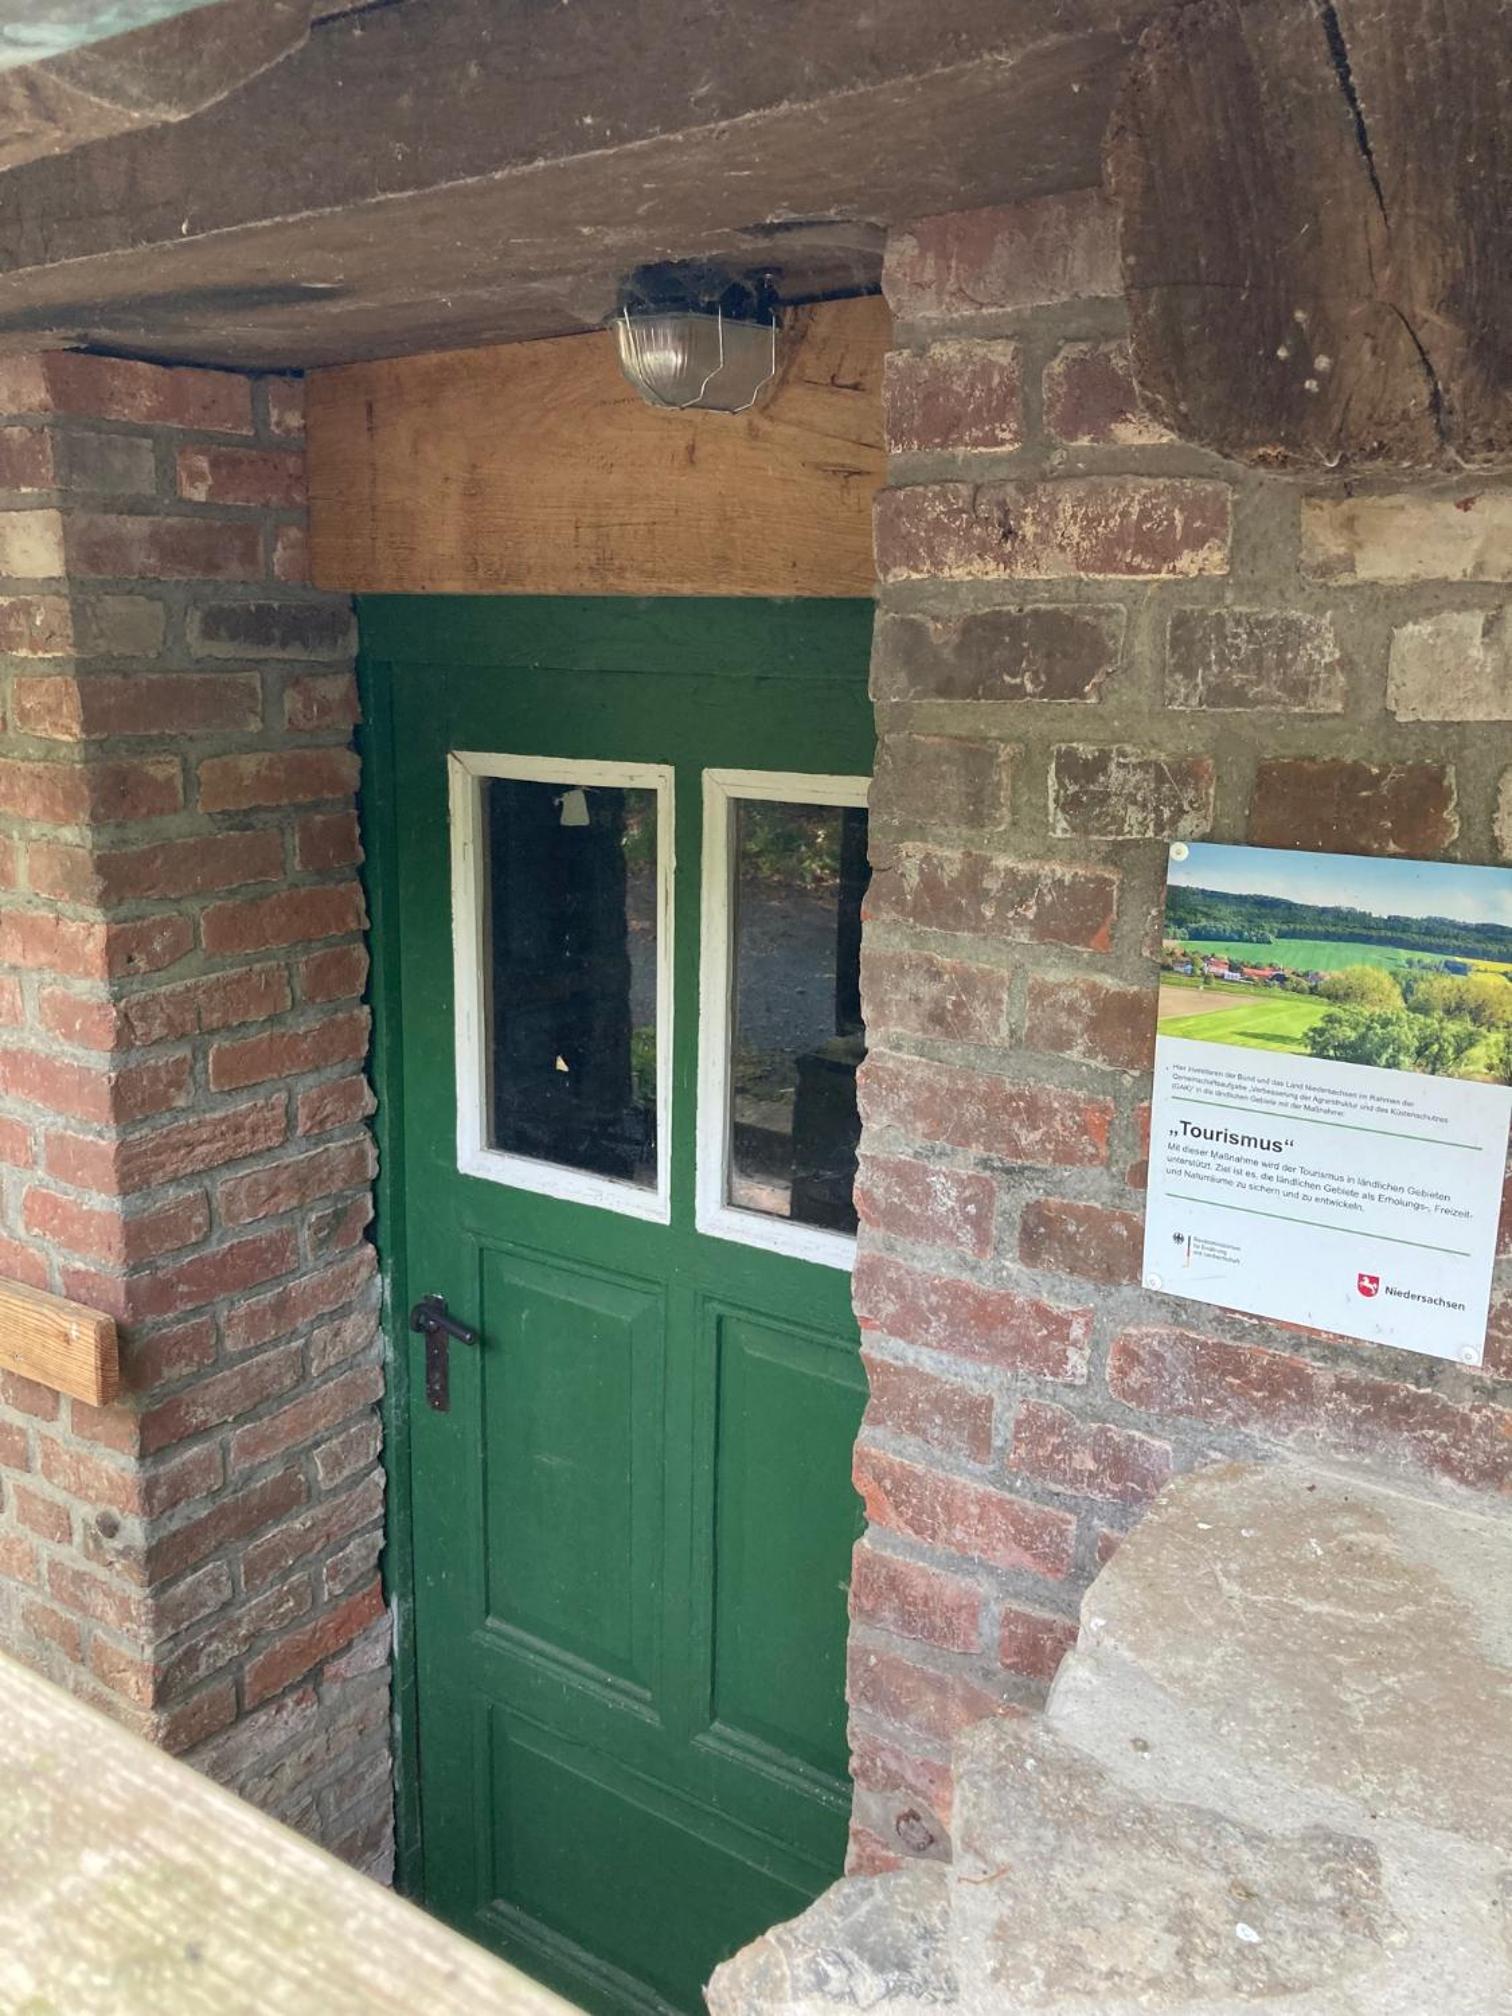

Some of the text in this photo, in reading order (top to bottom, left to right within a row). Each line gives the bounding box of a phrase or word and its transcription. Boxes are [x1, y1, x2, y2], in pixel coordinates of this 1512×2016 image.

[1237, 1073, 1255, 1082] Bund
[1286, 1080, 1304, 1089] Land
[1360, 1104, 1374, 1112] und
[1169, 1119, 1294, 1153] „Tourismus“
[1168, 1142, 1451, 1202] Mit dieser Maßnahme wird der Tourismus in ländlichen Gebieten
[1215, 1163, 1231, 1173] Ziel
[1233, 1167, 1243, 1176] ist
[1260, 1172, 1274, 1182] die
[1276, 1175, 1321, 1191] ländlichen
[1323, 1184, 1360, 1199] Gebiete
[1361, 1192, 1375, 1201] als
[1166, 1168, 1365, 1213] und Naturräume zu sichern und zu entwickeln.
[1385, 1286, 1465, 1312] Niedersachsen
